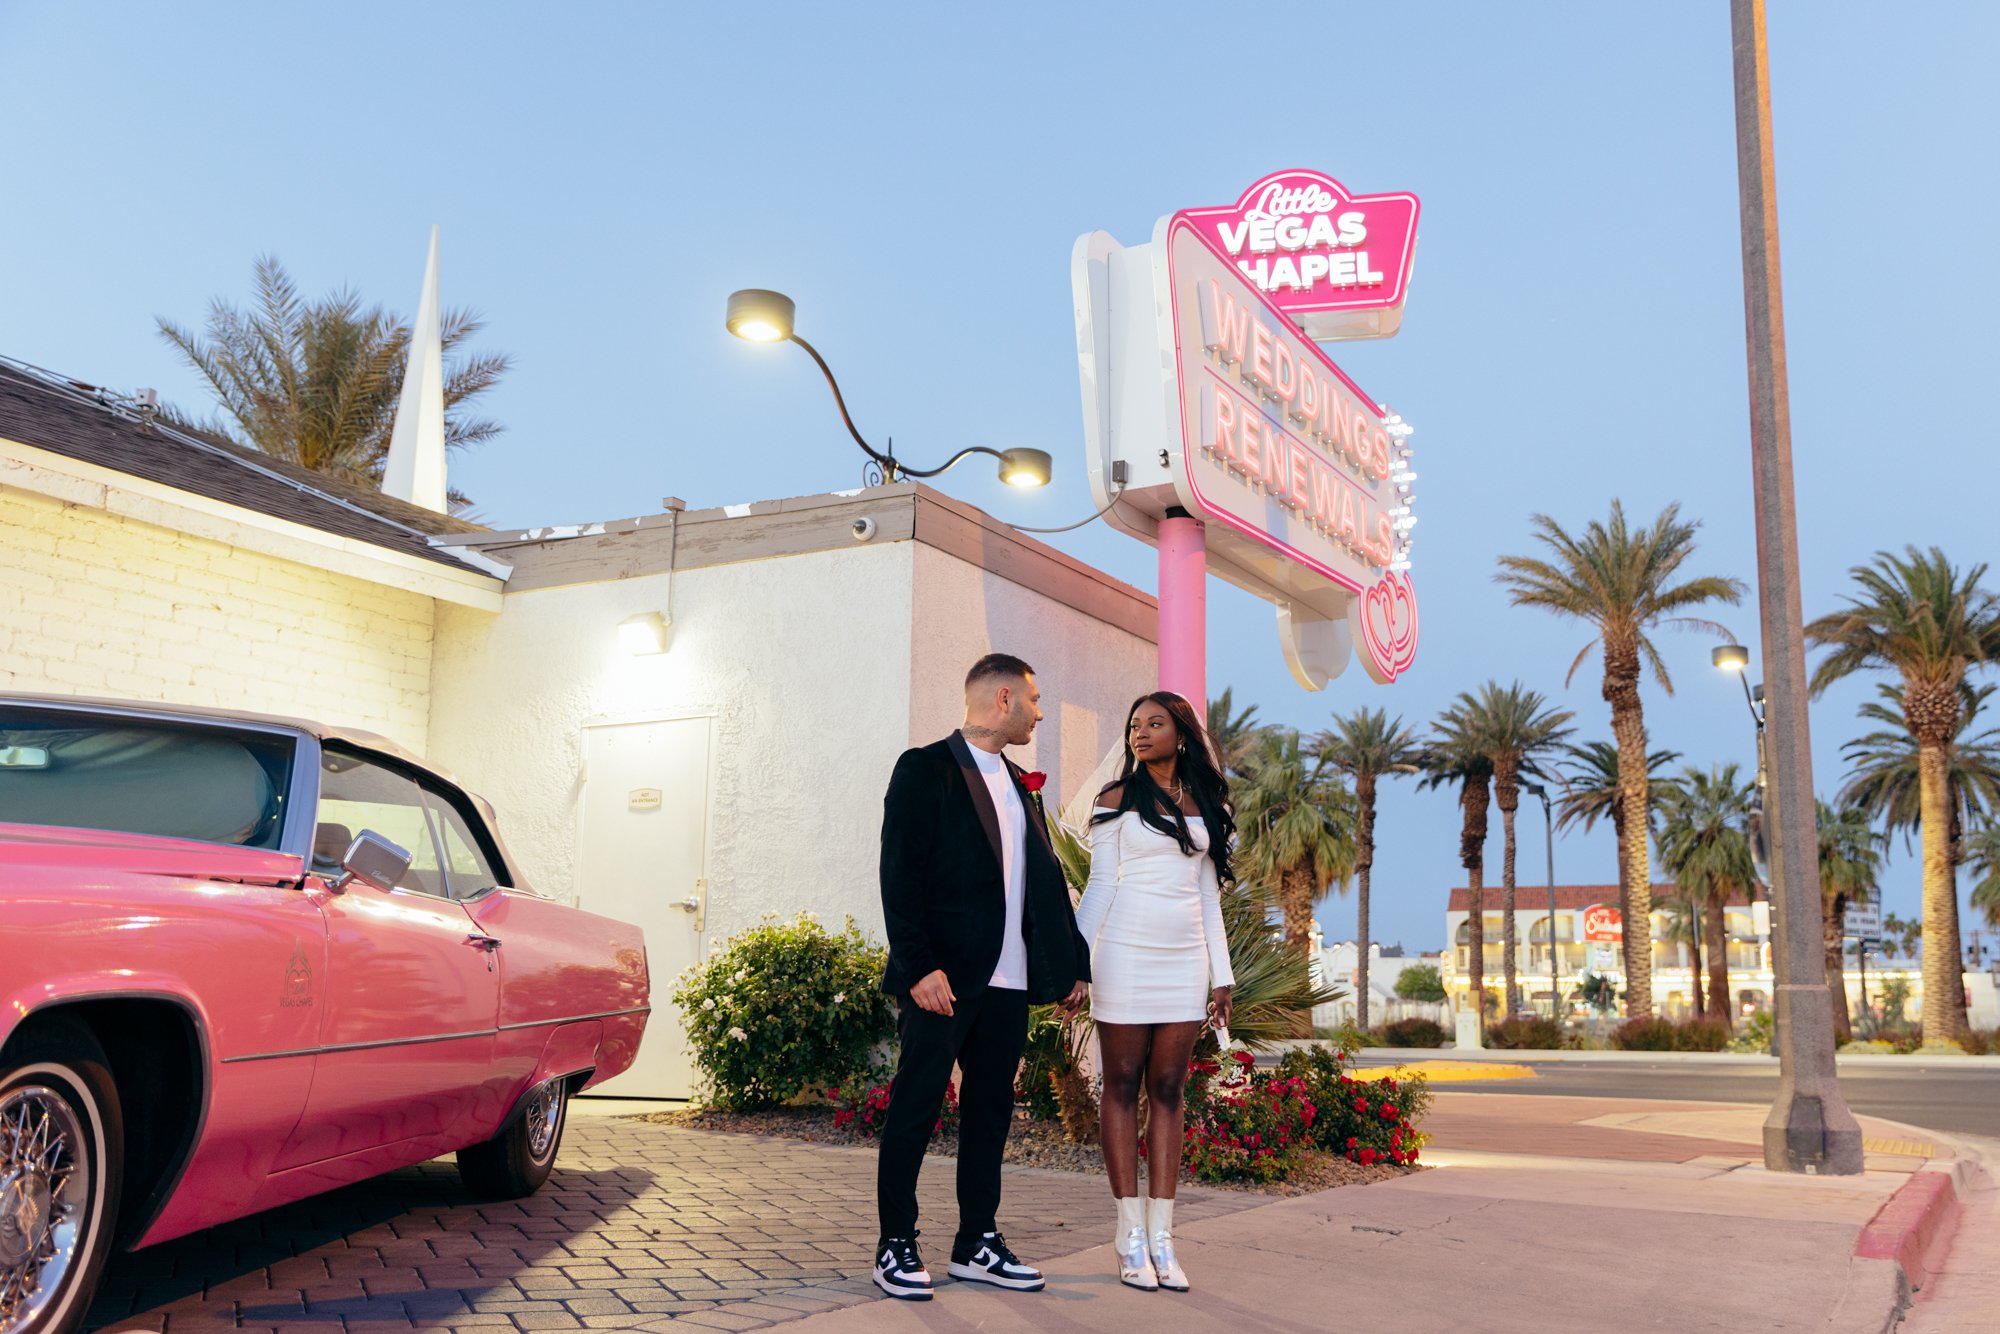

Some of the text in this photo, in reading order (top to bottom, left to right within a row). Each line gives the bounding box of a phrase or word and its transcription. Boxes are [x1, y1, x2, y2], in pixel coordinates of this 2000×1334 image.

[1244, 183, 1338, 221] Little
[1216, 212, 1367, 254] VEGAS
[1237, 252, 1384, 293] HAPEL
[1210, 276, 1390, 482] WEDDINGS
[1213, 382, 1393, 568] RENEWALS
